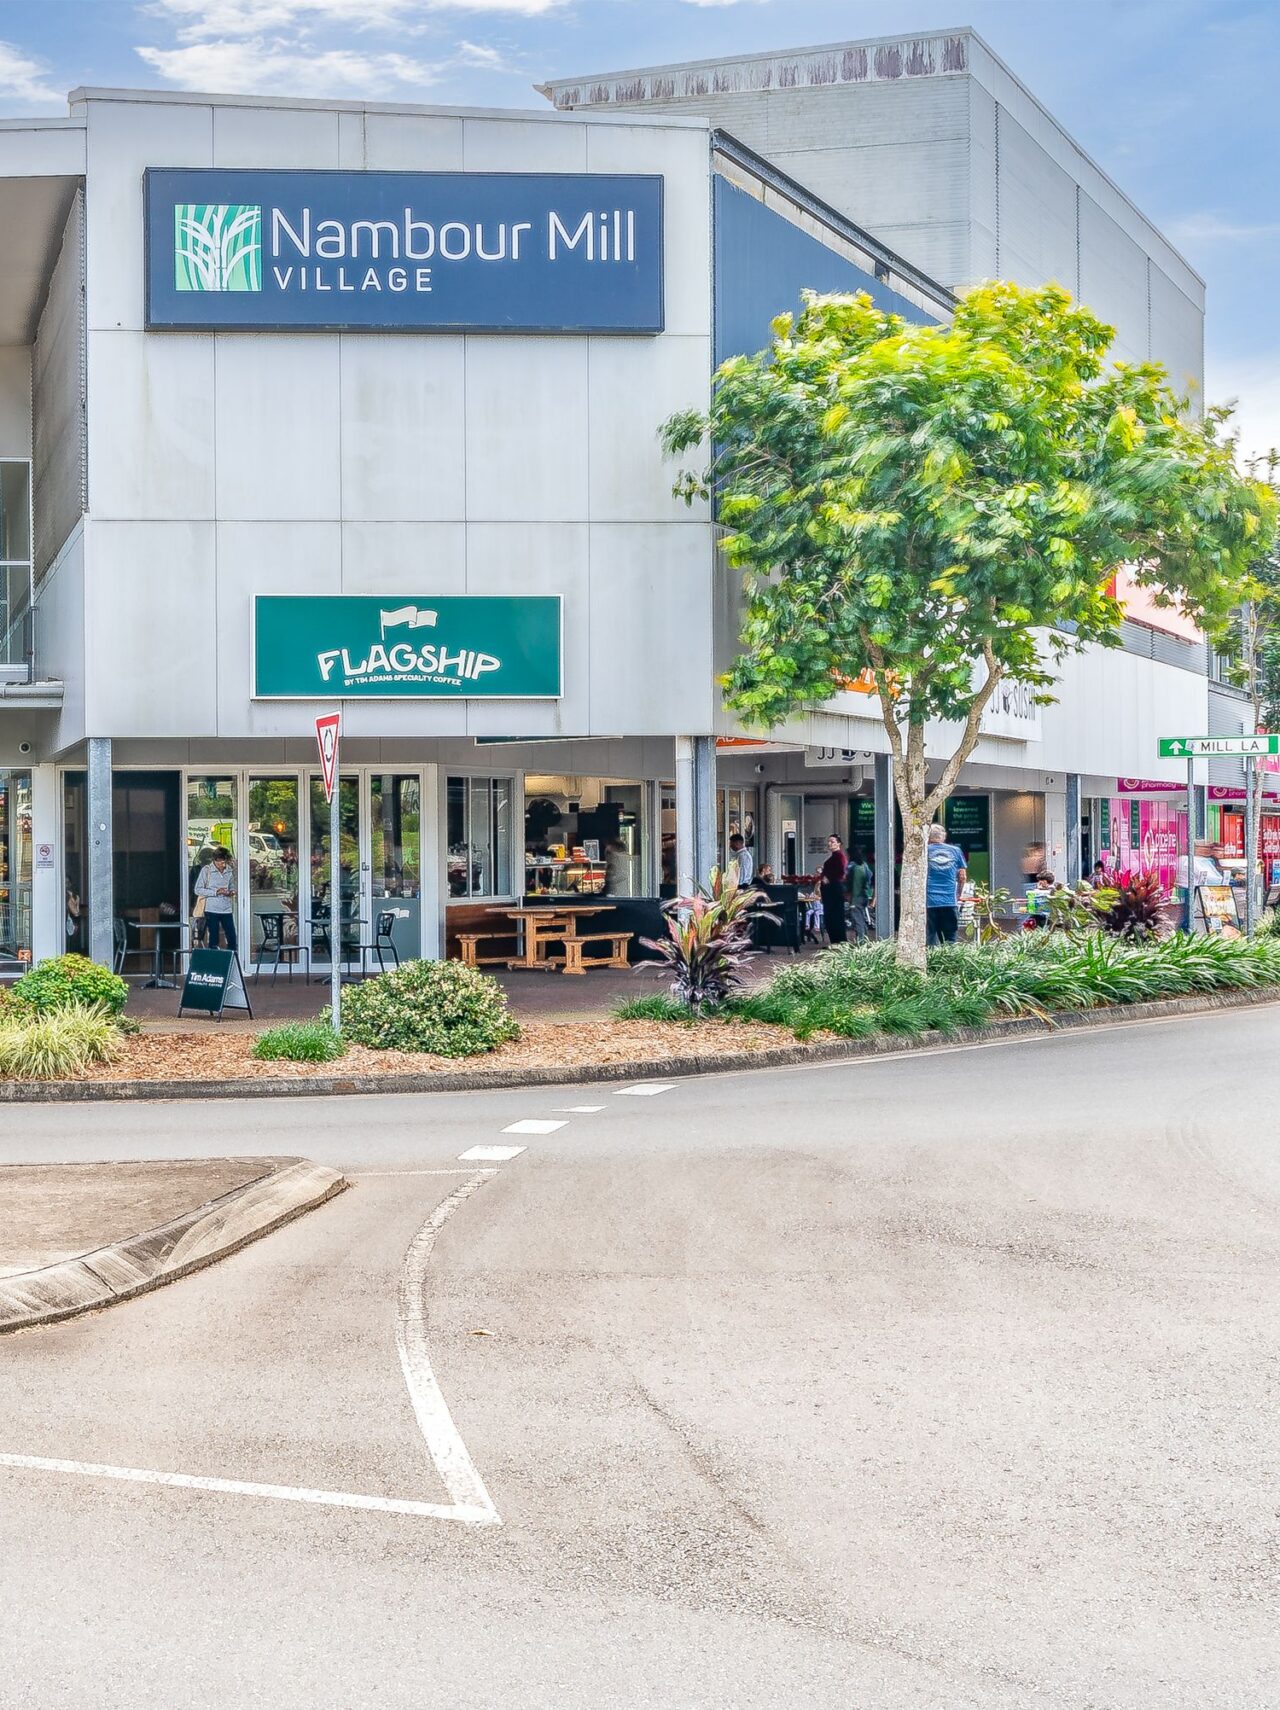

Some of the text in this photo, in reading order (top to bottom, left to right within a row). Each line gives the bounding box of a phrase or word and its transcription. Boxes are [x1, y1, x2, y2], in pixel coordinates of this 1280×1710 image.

[271, 207, 636, 262] Nambour Mill
[272, 266, 433, 292] VILLAGE
[317, 643, 501, 680] FLAGSHIP
[344, 674, 462, 686] BY TIM ADAMS SPECIALTY COFFEE
[1200, 740, 1260, 752] MILL LA
[1141, 781, 1177, 790] pharmacy
[190, 972, 224, 984] Tim Adams
